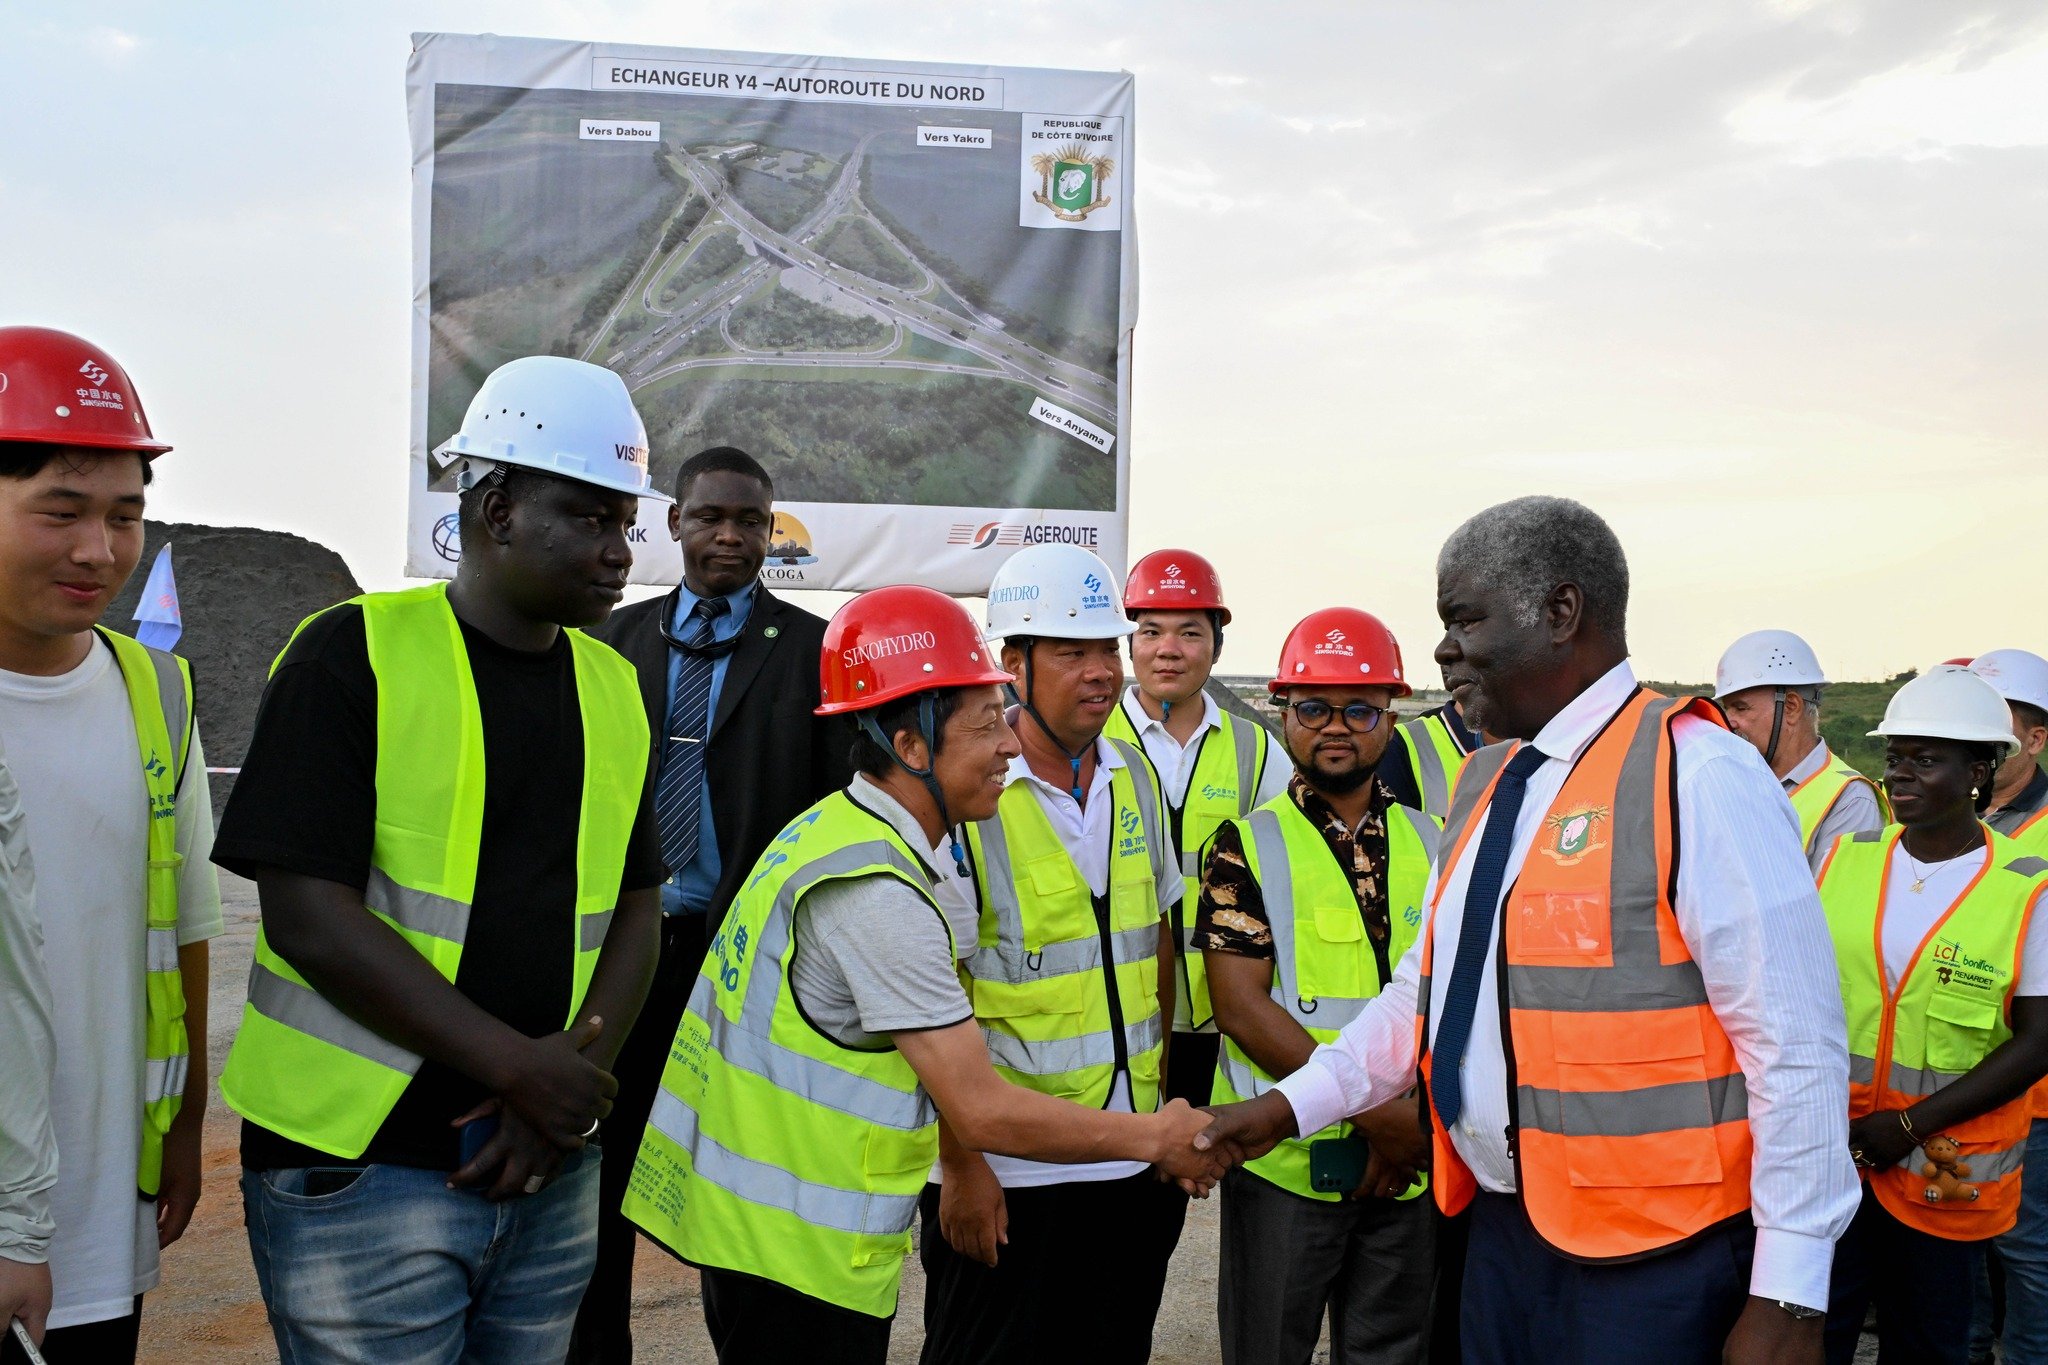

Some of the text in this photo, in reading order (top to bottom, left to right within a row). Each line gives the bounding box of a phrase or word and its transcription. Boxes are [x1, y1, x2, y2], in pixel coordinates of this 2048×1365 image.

[611, 67, 729, 88] ECHANGEUR
[735, 74, 758, 90] Y4
[896, 83, 924, 98] DU
[930, 86, 985, 101] NORD
[587, 126, 652, 137] Vers Dabou
[1043, 120, 1102, 130] REPUBLIQUE
[924, 132, 985, 144] Vers Yakro
[1031, 131, 1114, 142] DE CÔTE D'IVOIRE
[1039, 406, 1105, 446] Vers Anyama
[1023, 525, 1098, 545] AGEROUTE
[843, 630, 936, 668] SINOHYDRO
[1954, 970, 1994, 986] RENARDET
